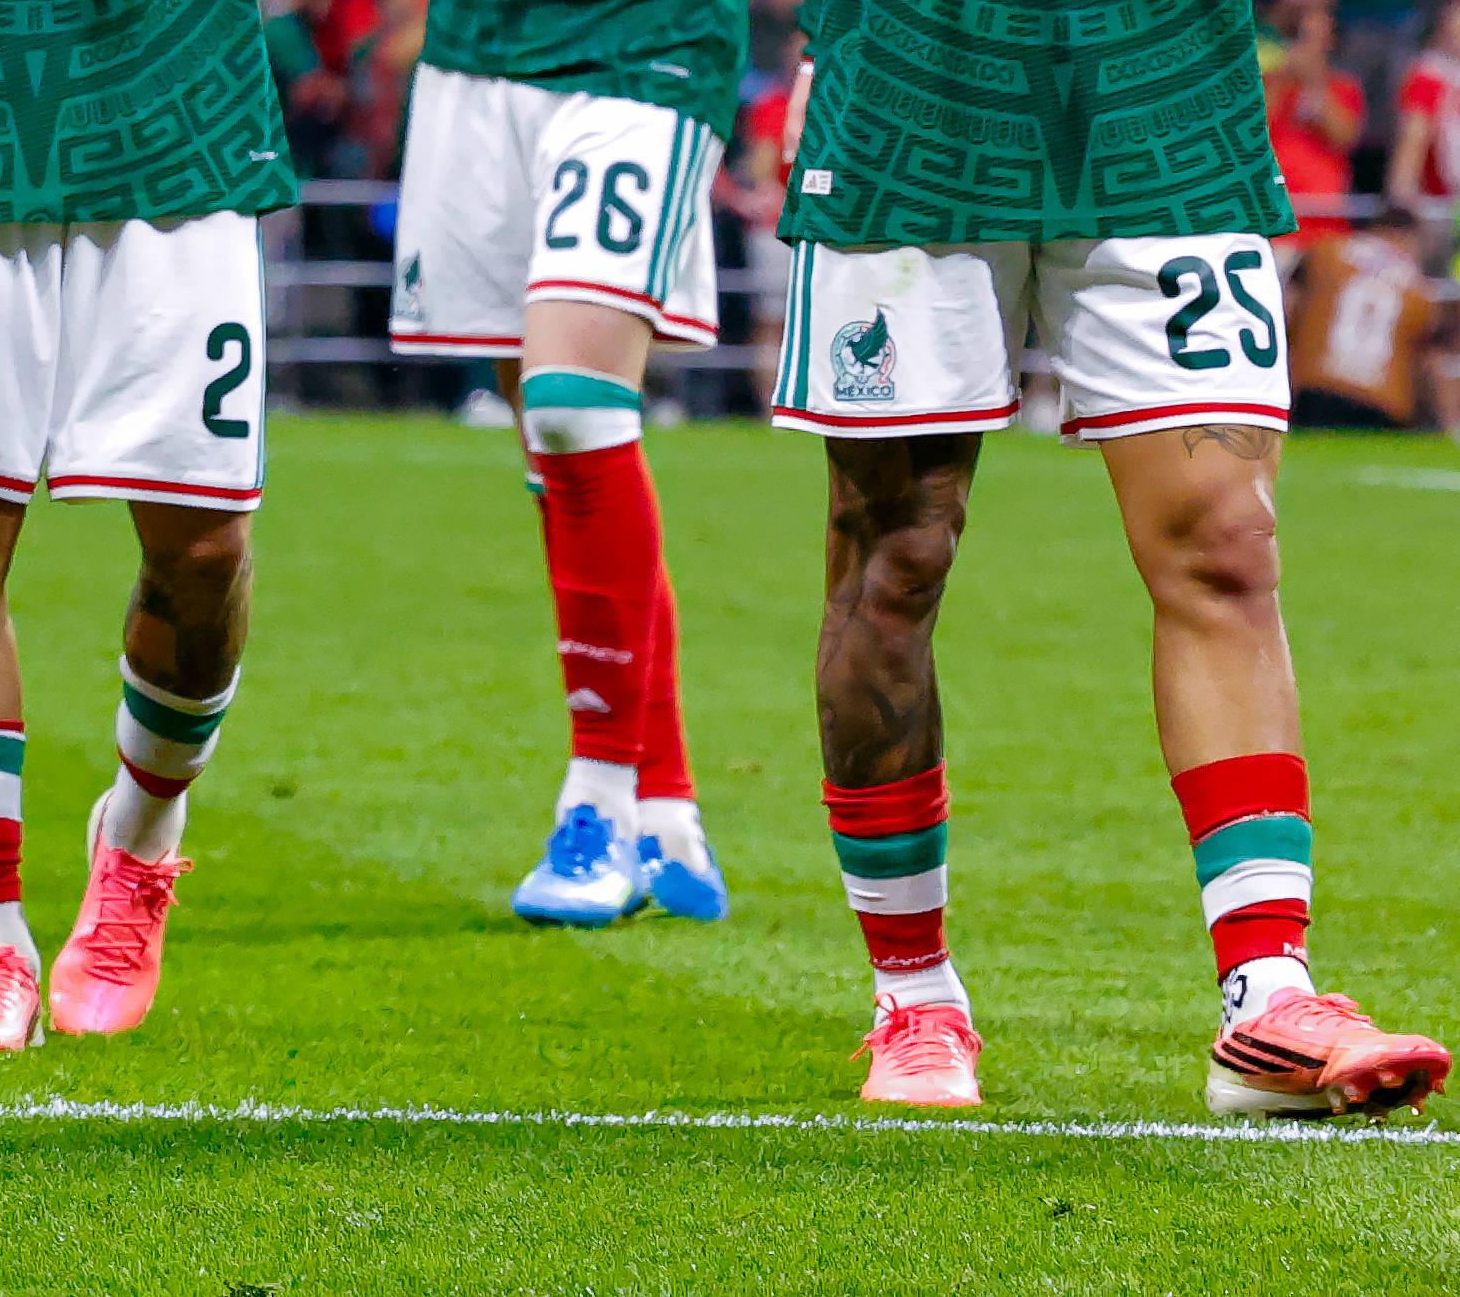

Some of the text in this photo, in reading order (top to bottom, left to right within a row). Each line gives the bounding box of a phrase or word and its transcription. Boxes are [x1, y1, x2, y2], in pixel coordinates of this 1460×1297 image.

[545, 159, 651, 255] 26
[1157, 249, 1279, 371] 25
[203, 322, 251, 438] 2
